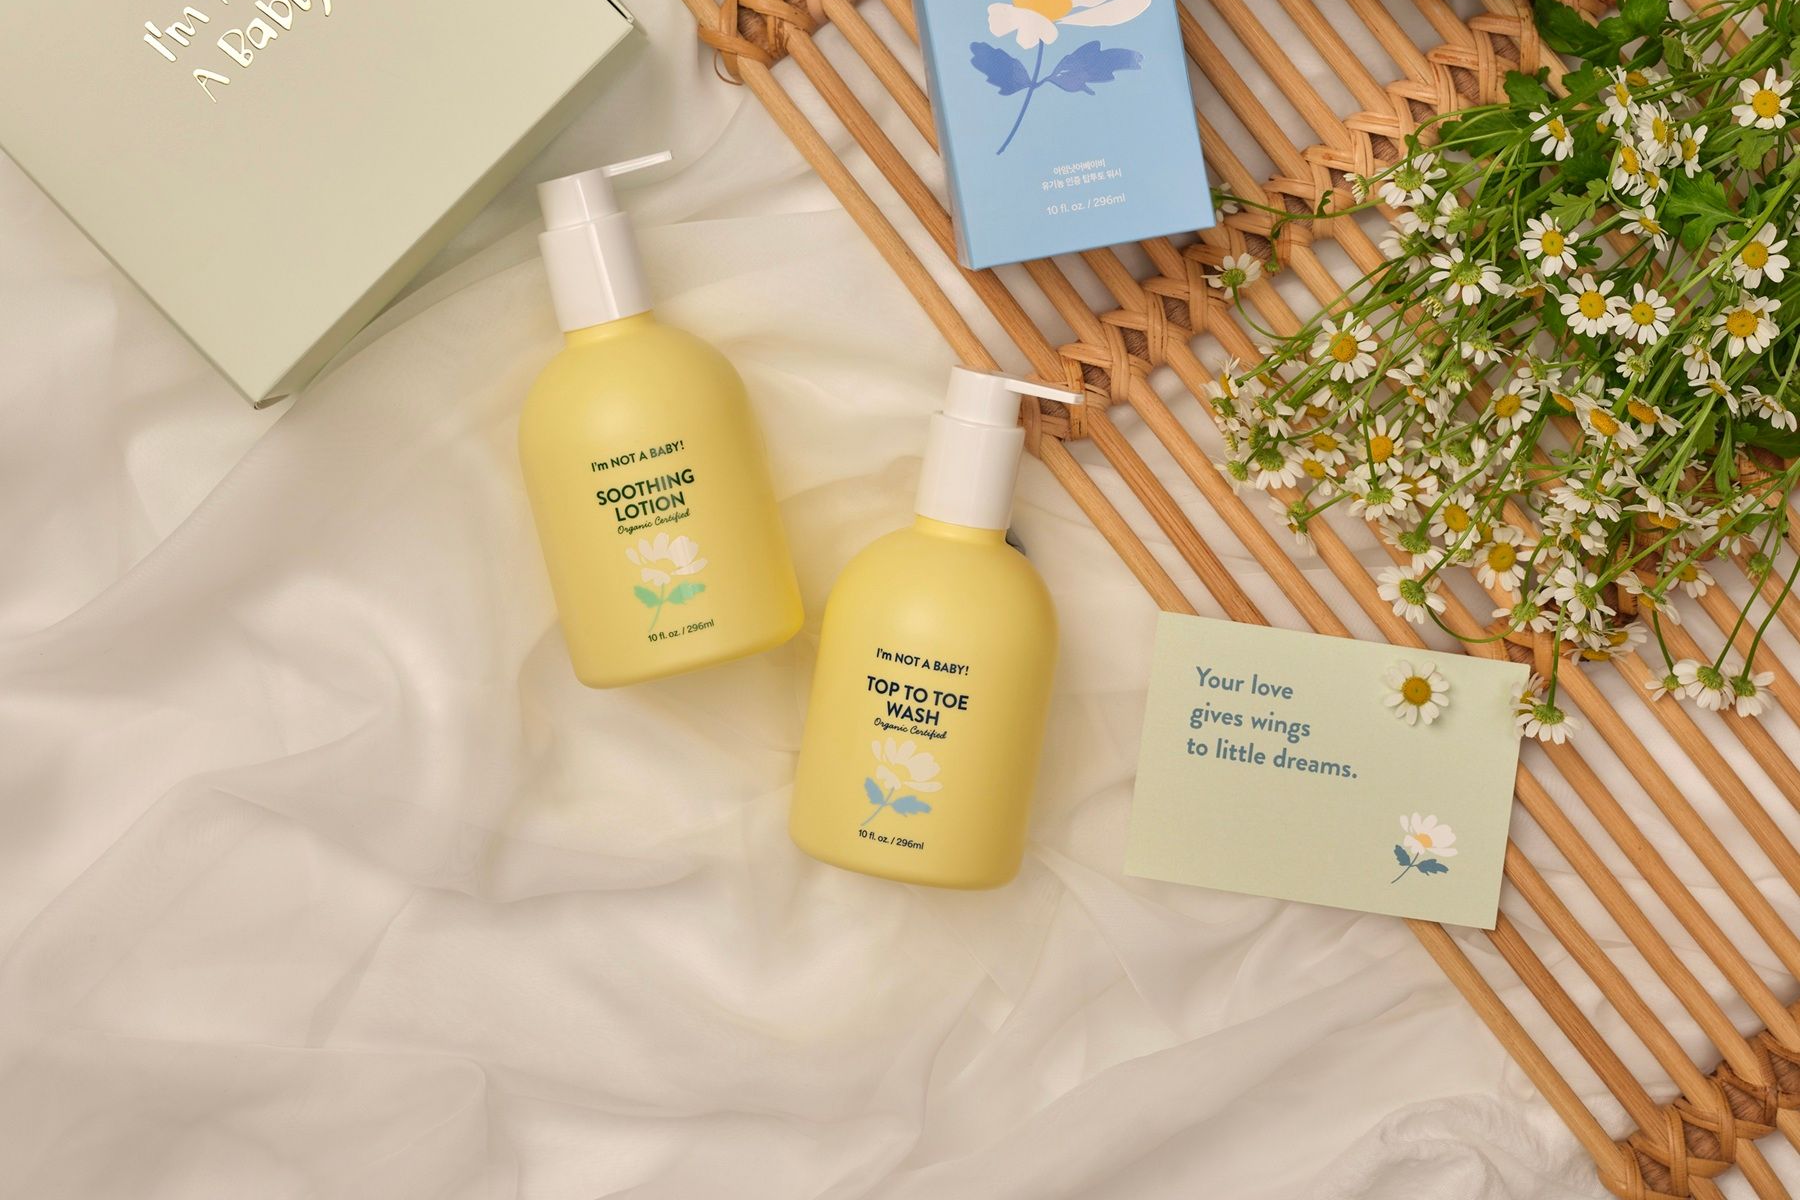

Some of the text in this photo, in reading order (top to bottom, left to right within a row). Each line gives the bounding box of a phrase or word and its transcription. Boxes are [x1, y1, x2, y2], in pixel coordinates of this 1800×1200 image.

[143, 6, 210, 63] I'm
[192, 68, 231, 103] A
[1046, 205, 1058, 215] 10
[1094, 193, 1126, 207] 296ml
[591, 440, 685, 472] I'm NOT A BABY!
[596, 468, 695, 506] SOOTHING
[615, 491, 686, 522] LOTION
[617, 508, 690, 535] Organic Certified
[648, 633, 658, 643] 10
[659, 631, 668, 640] fl.
[668, 629, 681, 638] oz.
[687, 618, 715, 634] 296ml
[876, 648, 970, 676] I'm NOT A BABY!
[866, 675, 969, 711] TOP TO TOE
[1196, 666, 1294, 700] Your love
[873, 717, 948, 740] Organic Certified
[886, 701, 940, 726] WASH
[1190, 702, 1311, 744] gives wings
[1187, 738, 1358, 780] to little dreams.
[858, 829, 868, 839] 10
[868, 831, 877, 841] fl.
[896, 836, 924, 850] 296ml
